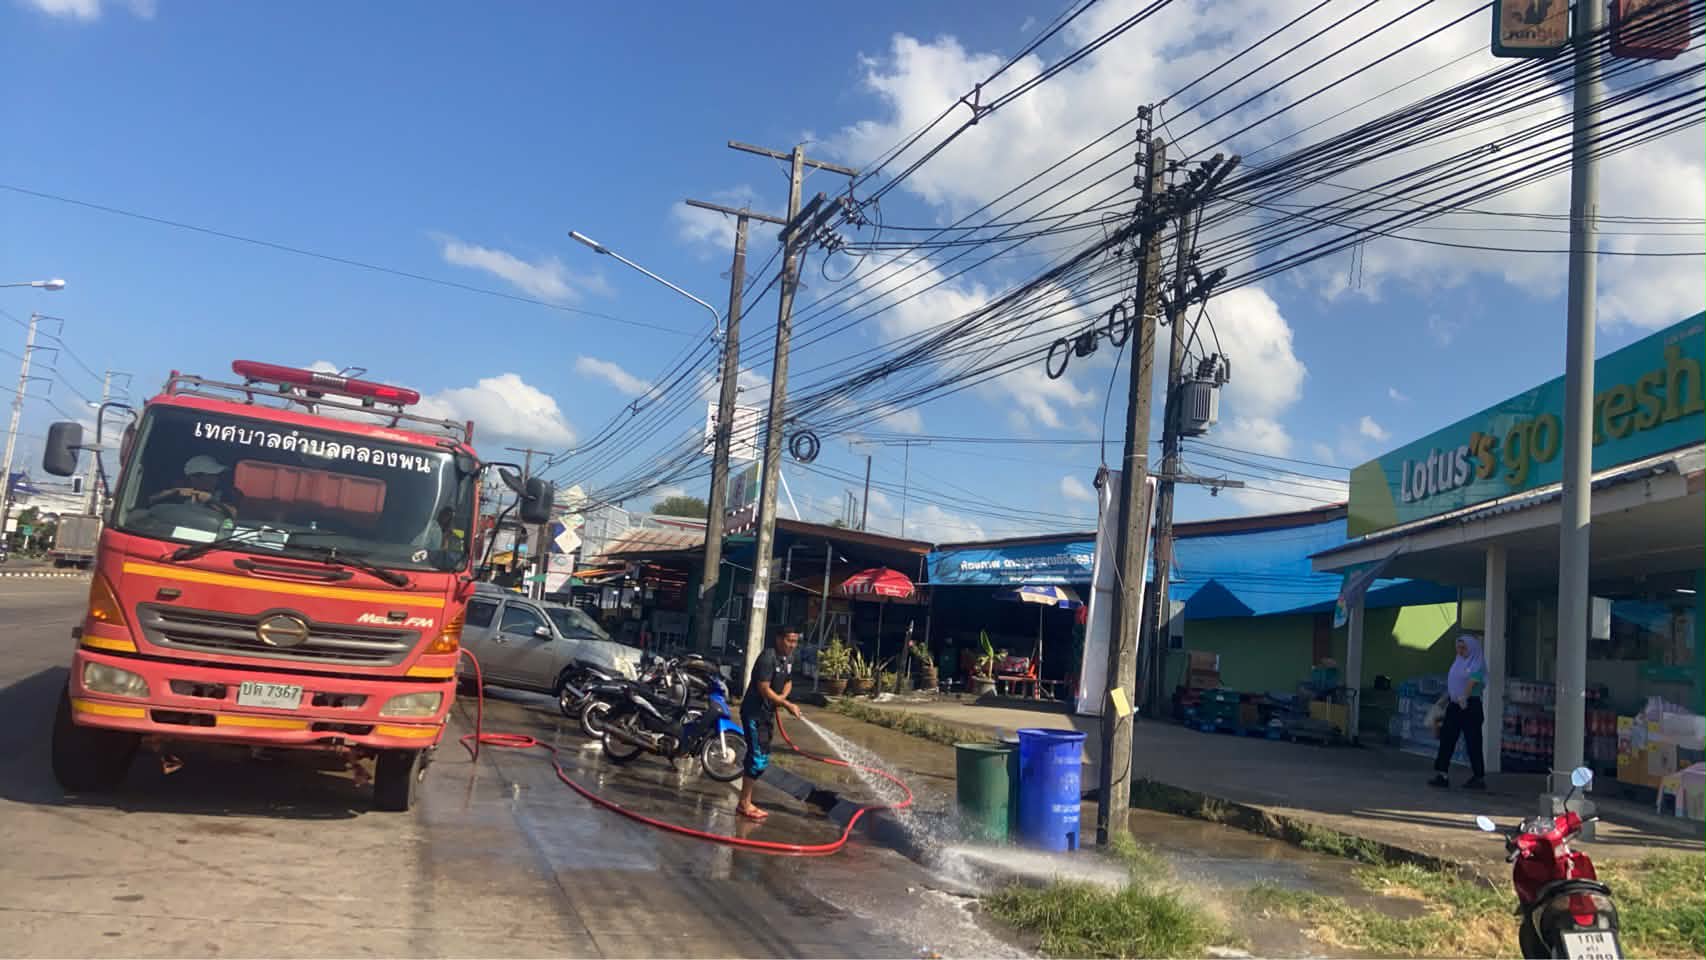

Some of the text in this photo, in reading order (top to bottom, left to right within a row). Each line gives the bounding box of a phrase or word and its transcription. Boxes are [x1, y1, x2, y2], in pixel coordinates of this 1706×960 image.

[194, 420, 431, 474] เทศบาลตำบลคลองพน
[1401, 346, 1706, 503] Lotus's go resh
[267, 685, 299, 699] 7367
